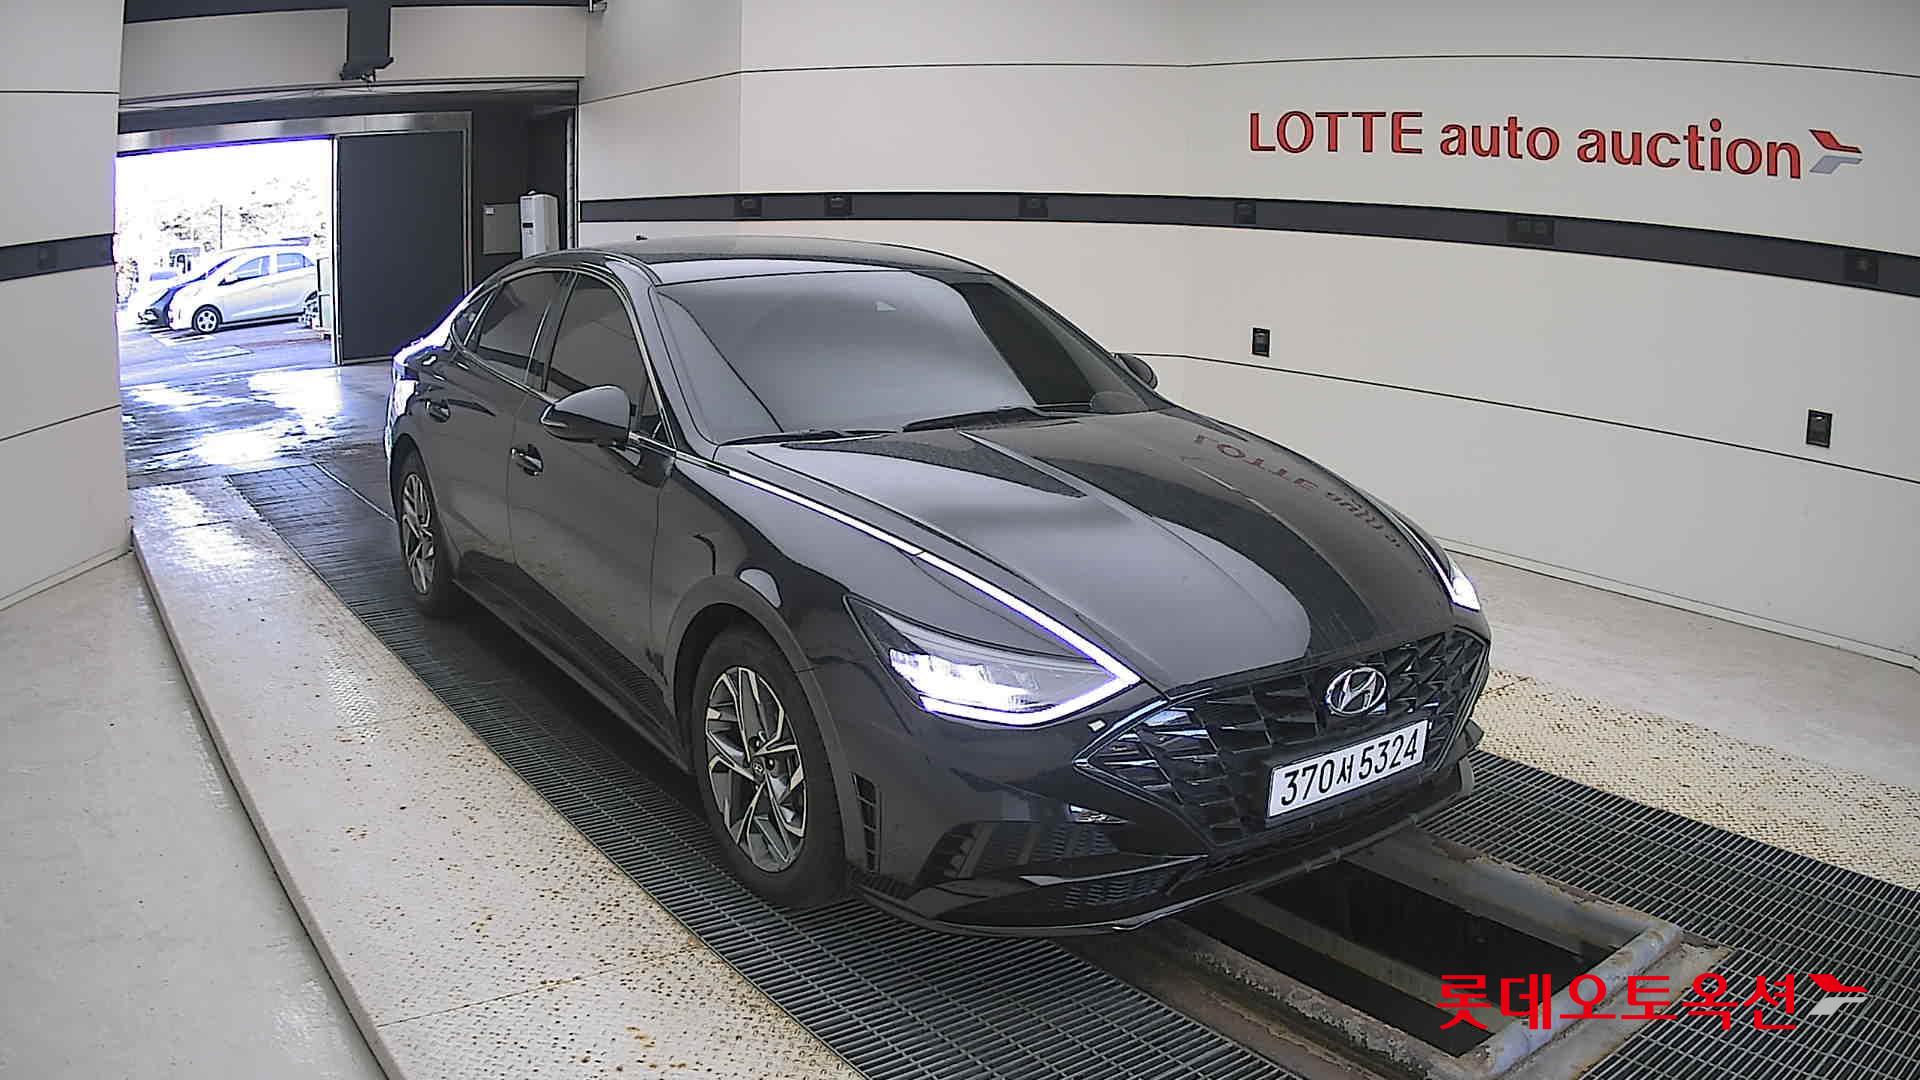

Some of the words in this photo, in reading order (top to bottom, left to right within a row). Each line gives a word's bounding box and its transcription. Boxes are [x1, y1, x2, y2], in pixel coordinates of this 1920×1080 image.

[1249, 111, 1424, 155] LOTTE
[1439, 116, 1561, 162] auto
[1576, 118, 1803, 180] auction
[1358, 728, 1420, 781] 5324
